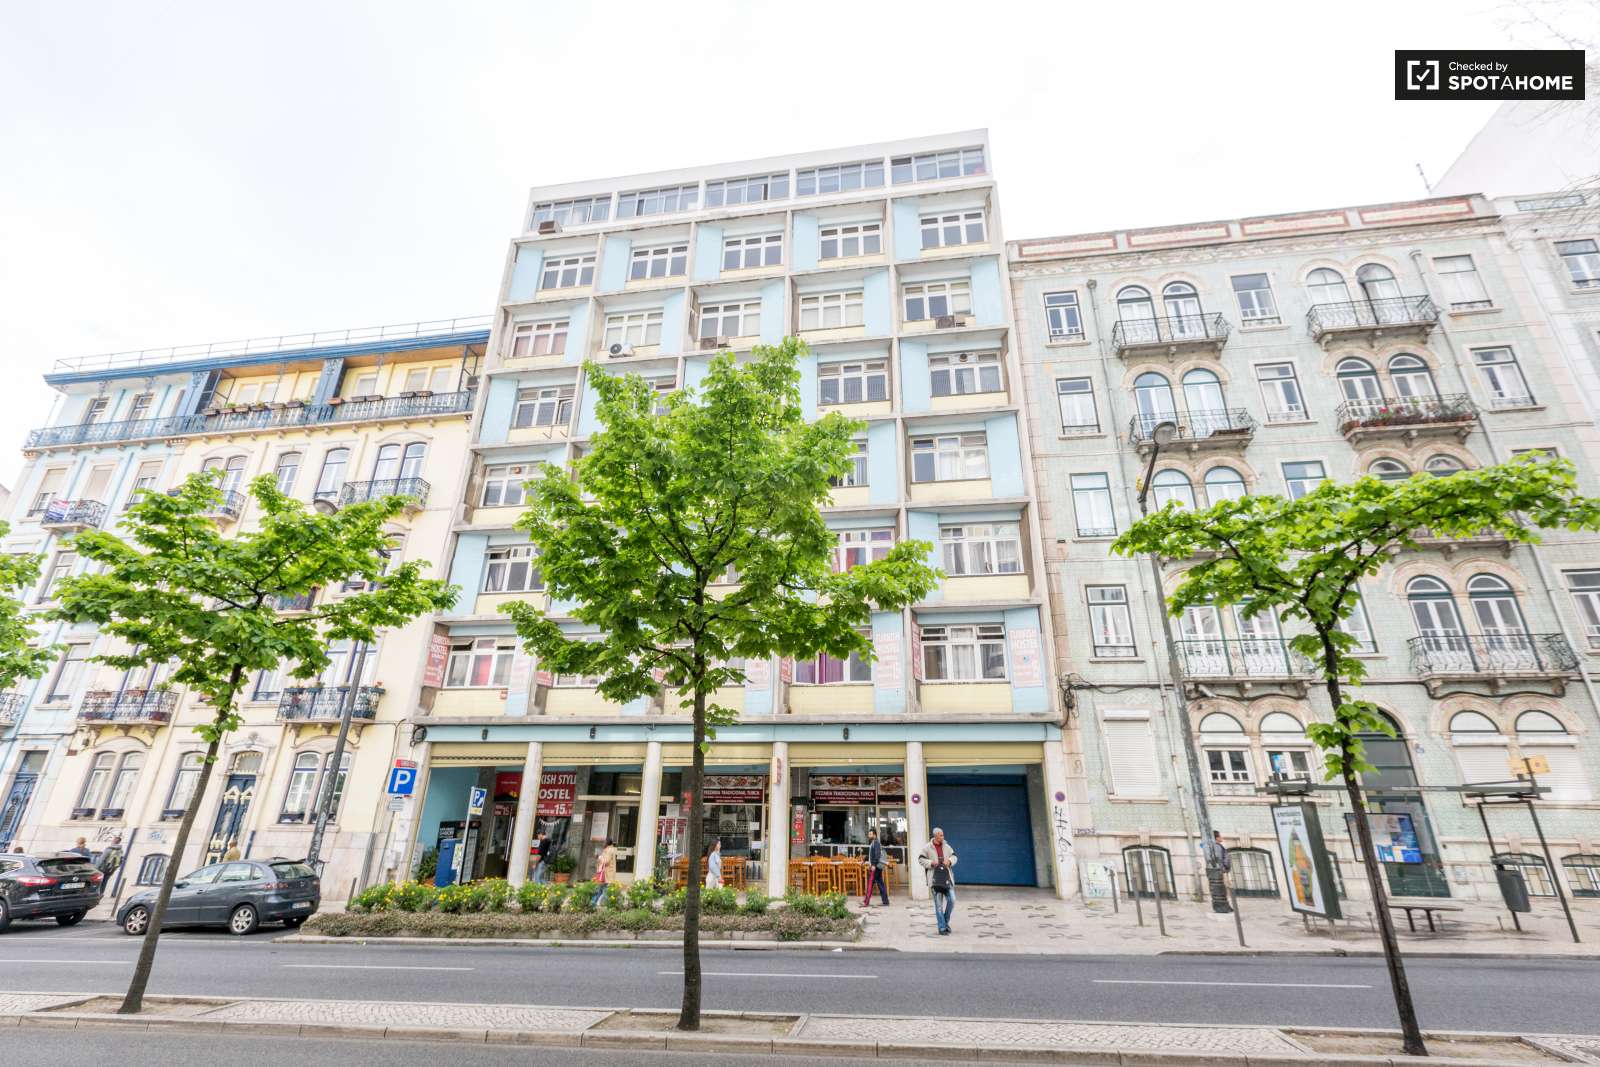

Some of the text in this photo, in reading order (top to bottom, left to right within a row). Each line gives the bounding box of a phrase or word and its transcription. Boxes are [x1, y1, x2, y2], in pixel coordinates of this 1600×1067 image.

[393, 769, 411, 792] P
[474, 790, 481, 800] P
[539, 788, 571, 800] OSTEL
